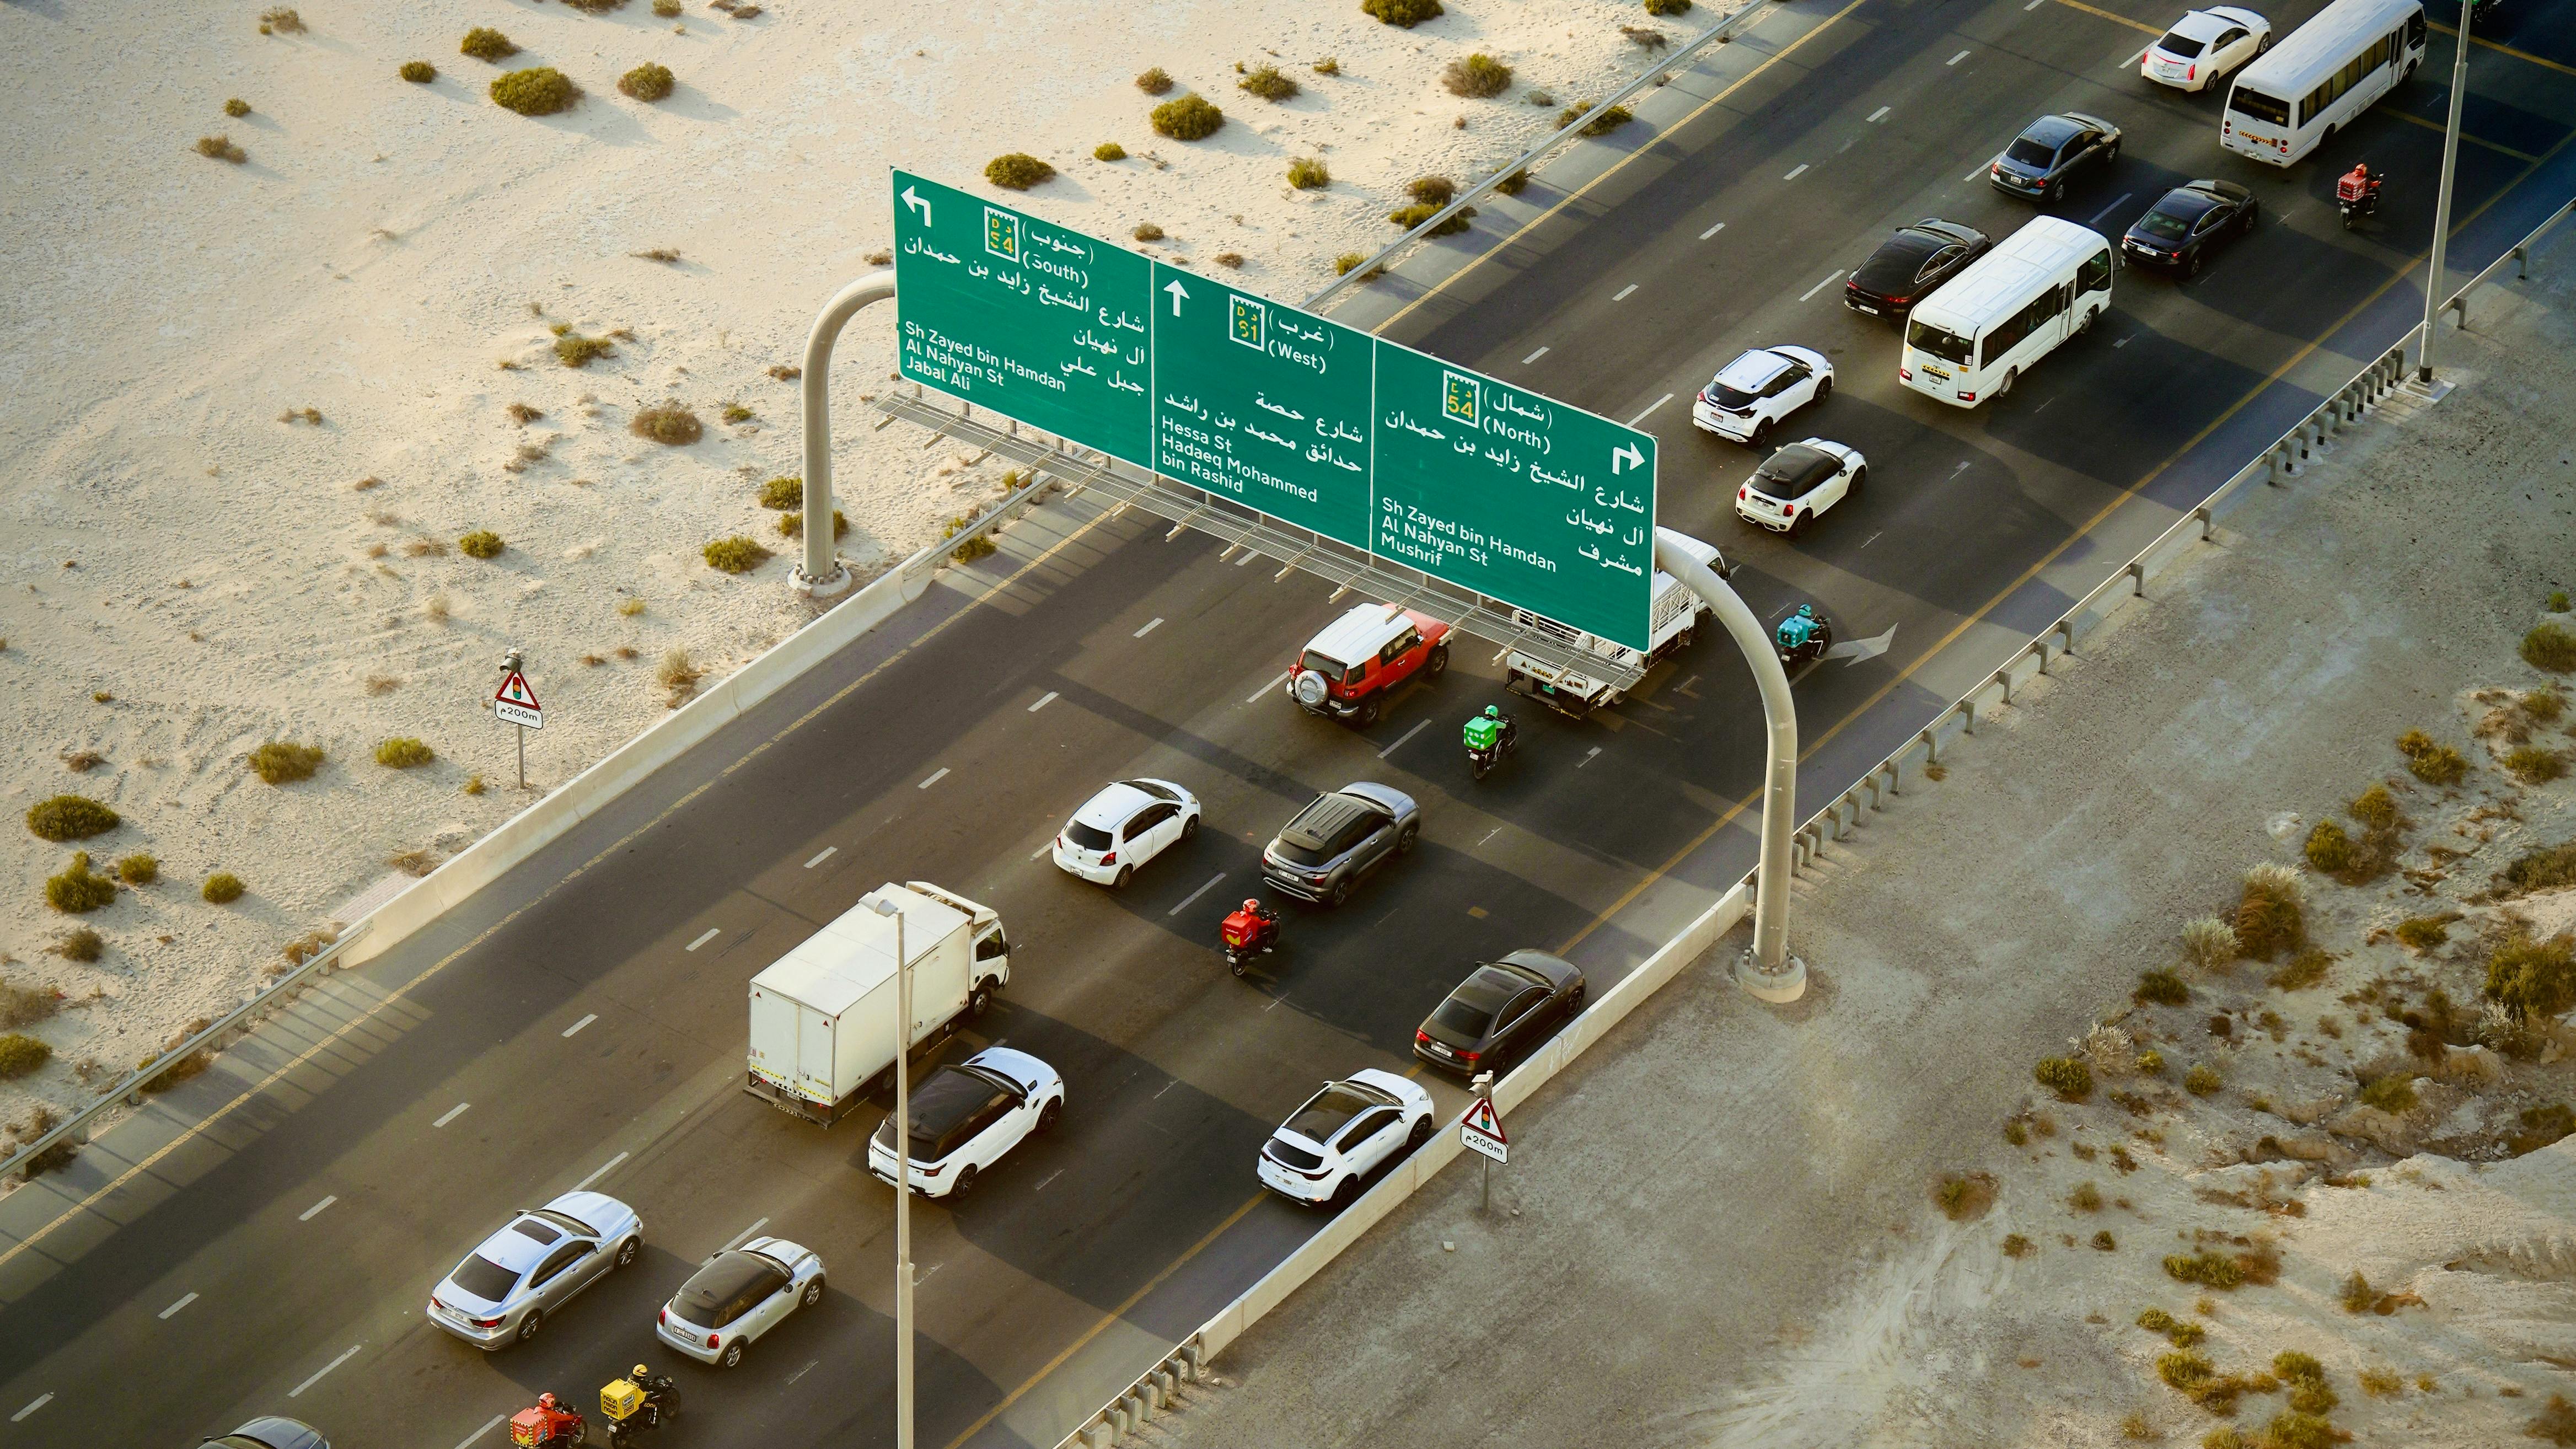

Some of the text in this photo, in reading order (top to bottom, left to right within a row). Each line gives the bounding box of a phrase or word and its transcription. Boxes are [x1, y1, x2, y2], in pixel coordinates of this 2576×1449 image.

[991, 218, 1000, 229] D
[905, 237, 1144, 332] شارع الشيخ زايد بن حمدان
[1023, 251, 1087, 288] (South)
[1237, 305, 1245, 316] D
[906, 321, 1065, 391] Sh Zayed bin Hamdan
[906, 339, 1003, 386] Al Nahyan St
[907, 356, 969, 390] Jabal Ali
[1061, 356, 1144, 396] جبل علي
[1269, 340, 1325, 374] (West)
[1255, 392, 1362, 442] شارع حصة
[1447, 395, 1474, 419] 54
[1163, 415, 1231, 453] Hessa St
[1165, 394, 1361, 471] حدائق محمد بن راشد
[1484, 416, 1550, 454] (North)
[1163, 433, 1317, 502] Hadaeq Mohammed
[1163, 450, 1242, 493] bin Rashid
[1386, 411, 1644, 513] شارع الشيخ زايد بن حمدان
[1382, 516, 1488, 566] Al Nahyan St
[1382, 533, 1442, 566] Mushrif
[1383, 497, 1555, 572] Sh Zayed bin Hamdan
[1579, 544, 1642, 576] مشرف
